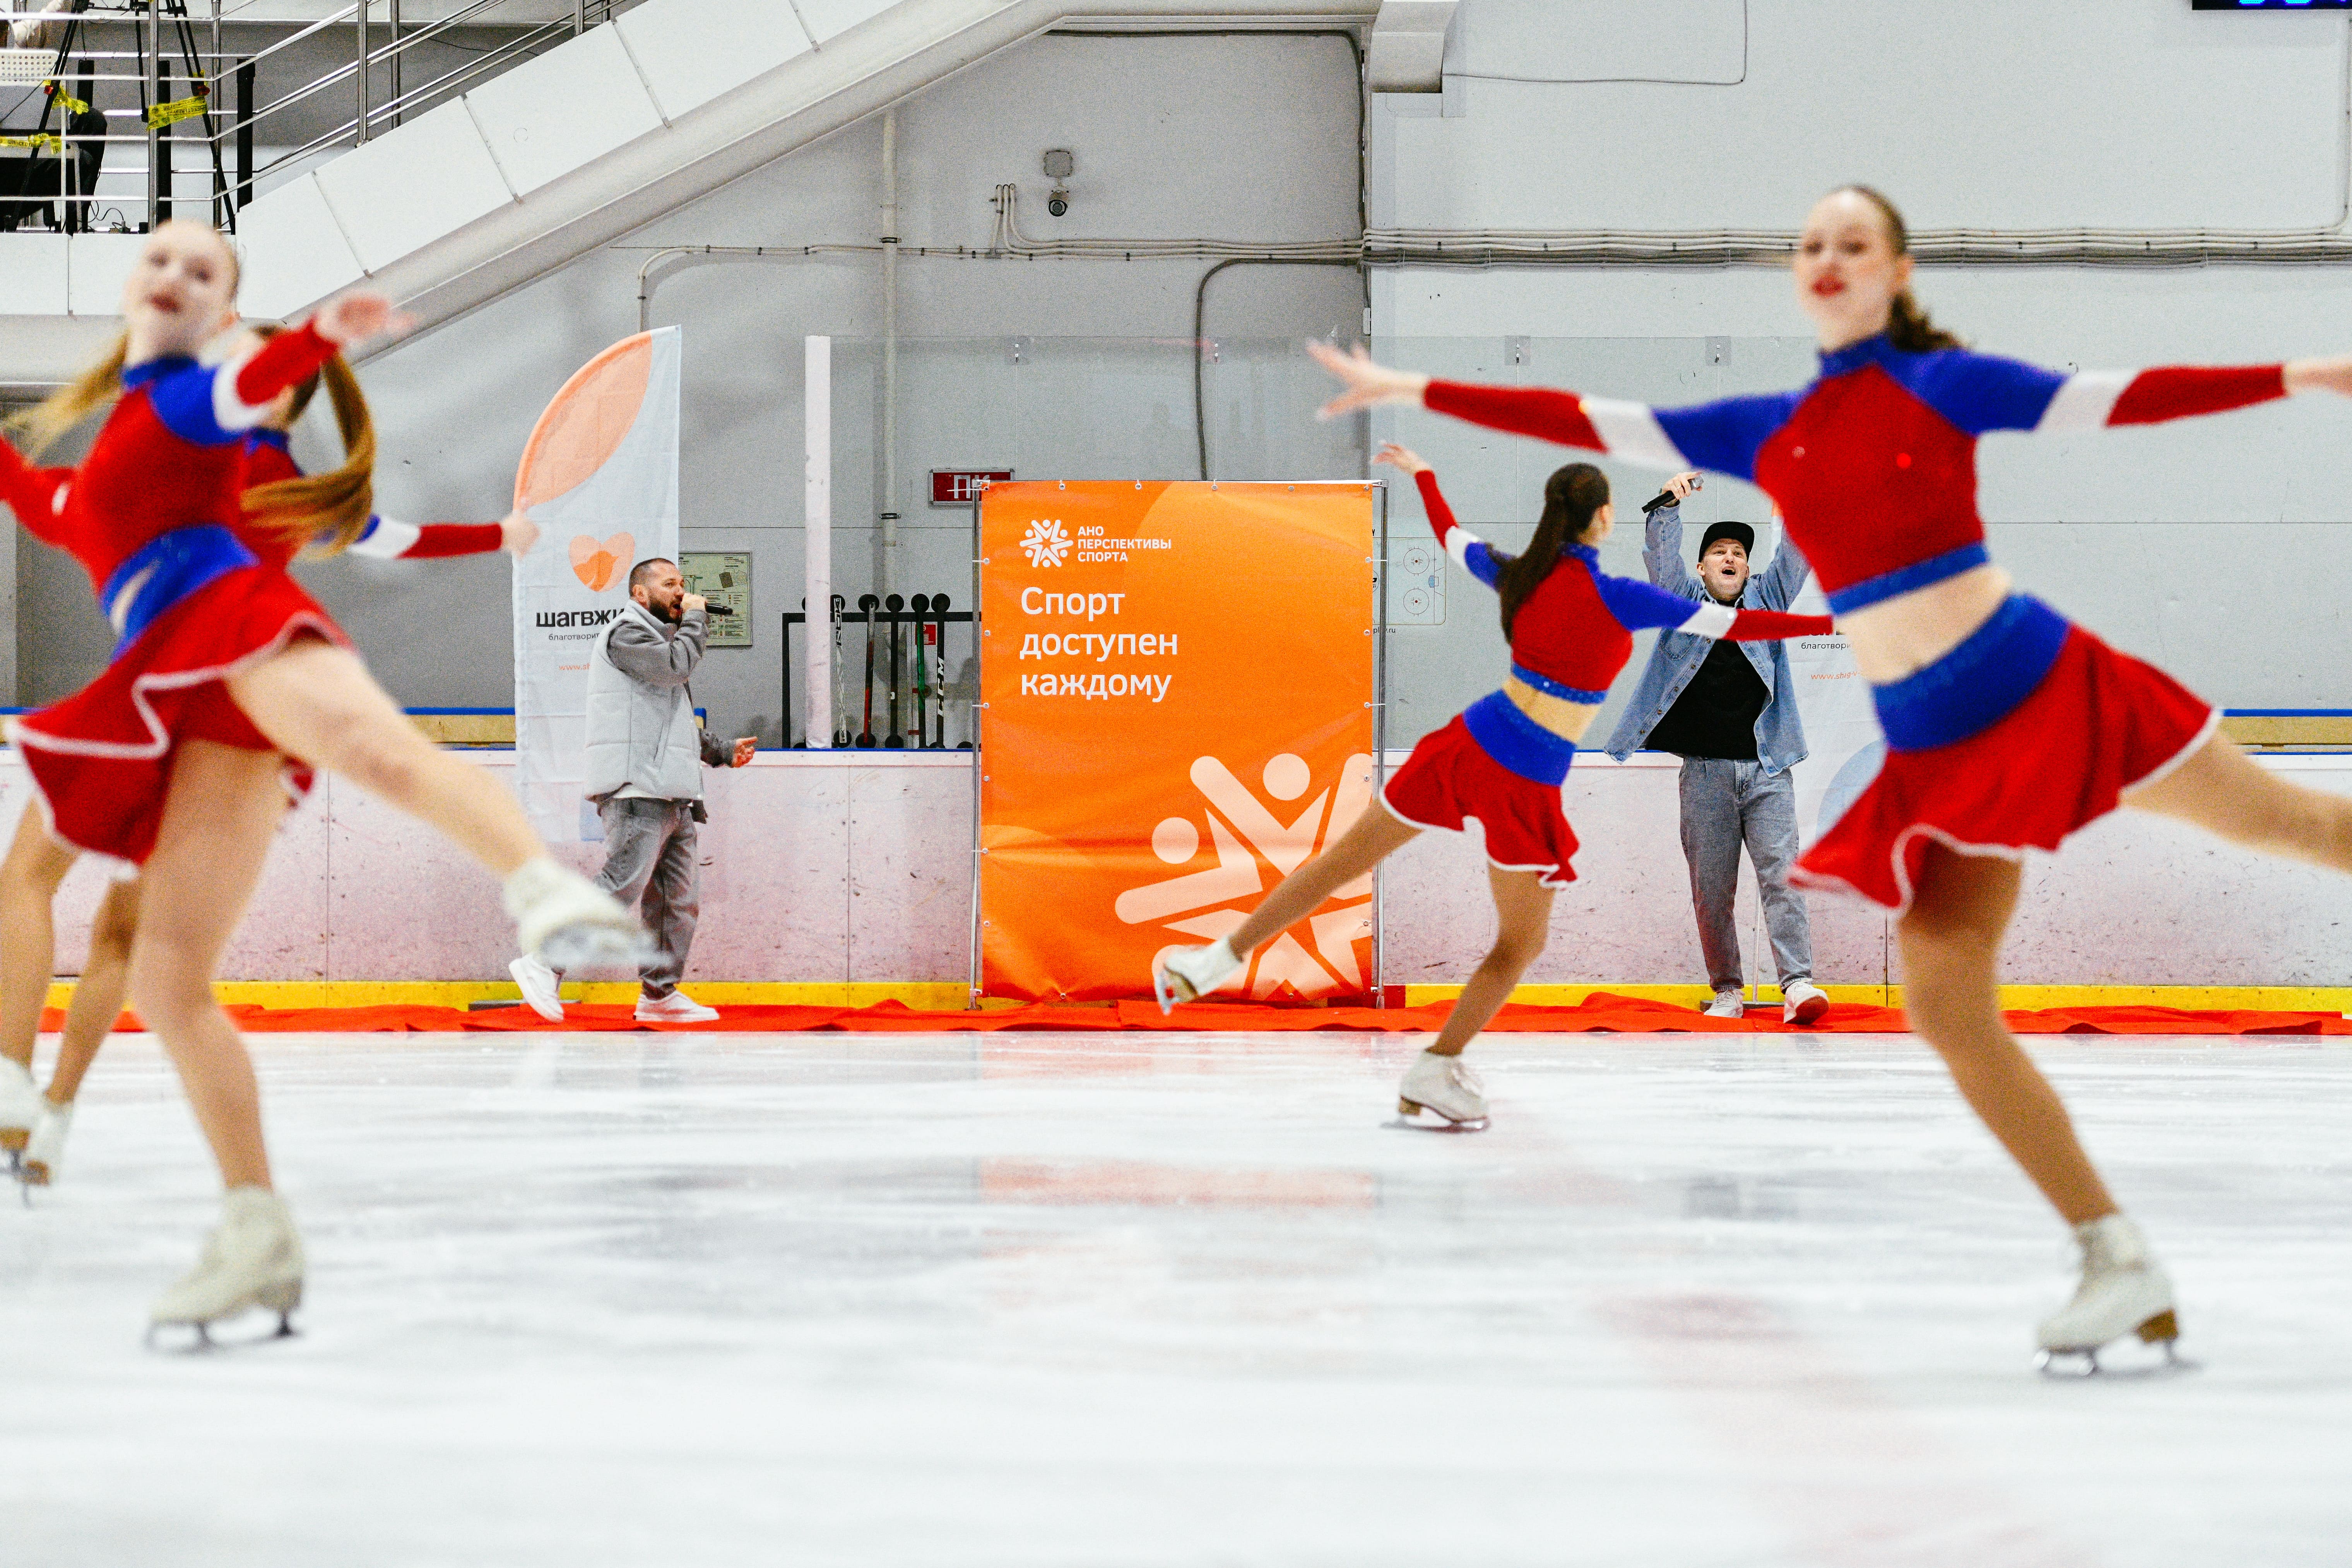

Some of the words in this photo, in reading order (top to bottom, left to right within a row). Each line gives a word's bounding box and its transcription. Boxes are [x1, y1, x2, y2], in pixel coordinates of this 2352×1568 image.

[1078, 526, 1104, 536] АНО
[1078, 539, 1171, 549] ПЕРСПЕКТИВЫ
[1078, 552, 1128, 562] СПОРТА
[1021, 586, 1125, 622] Спорт
[1019, 633, 1177, 662] доступен
[1021, 673, 1172, 703] каждому
